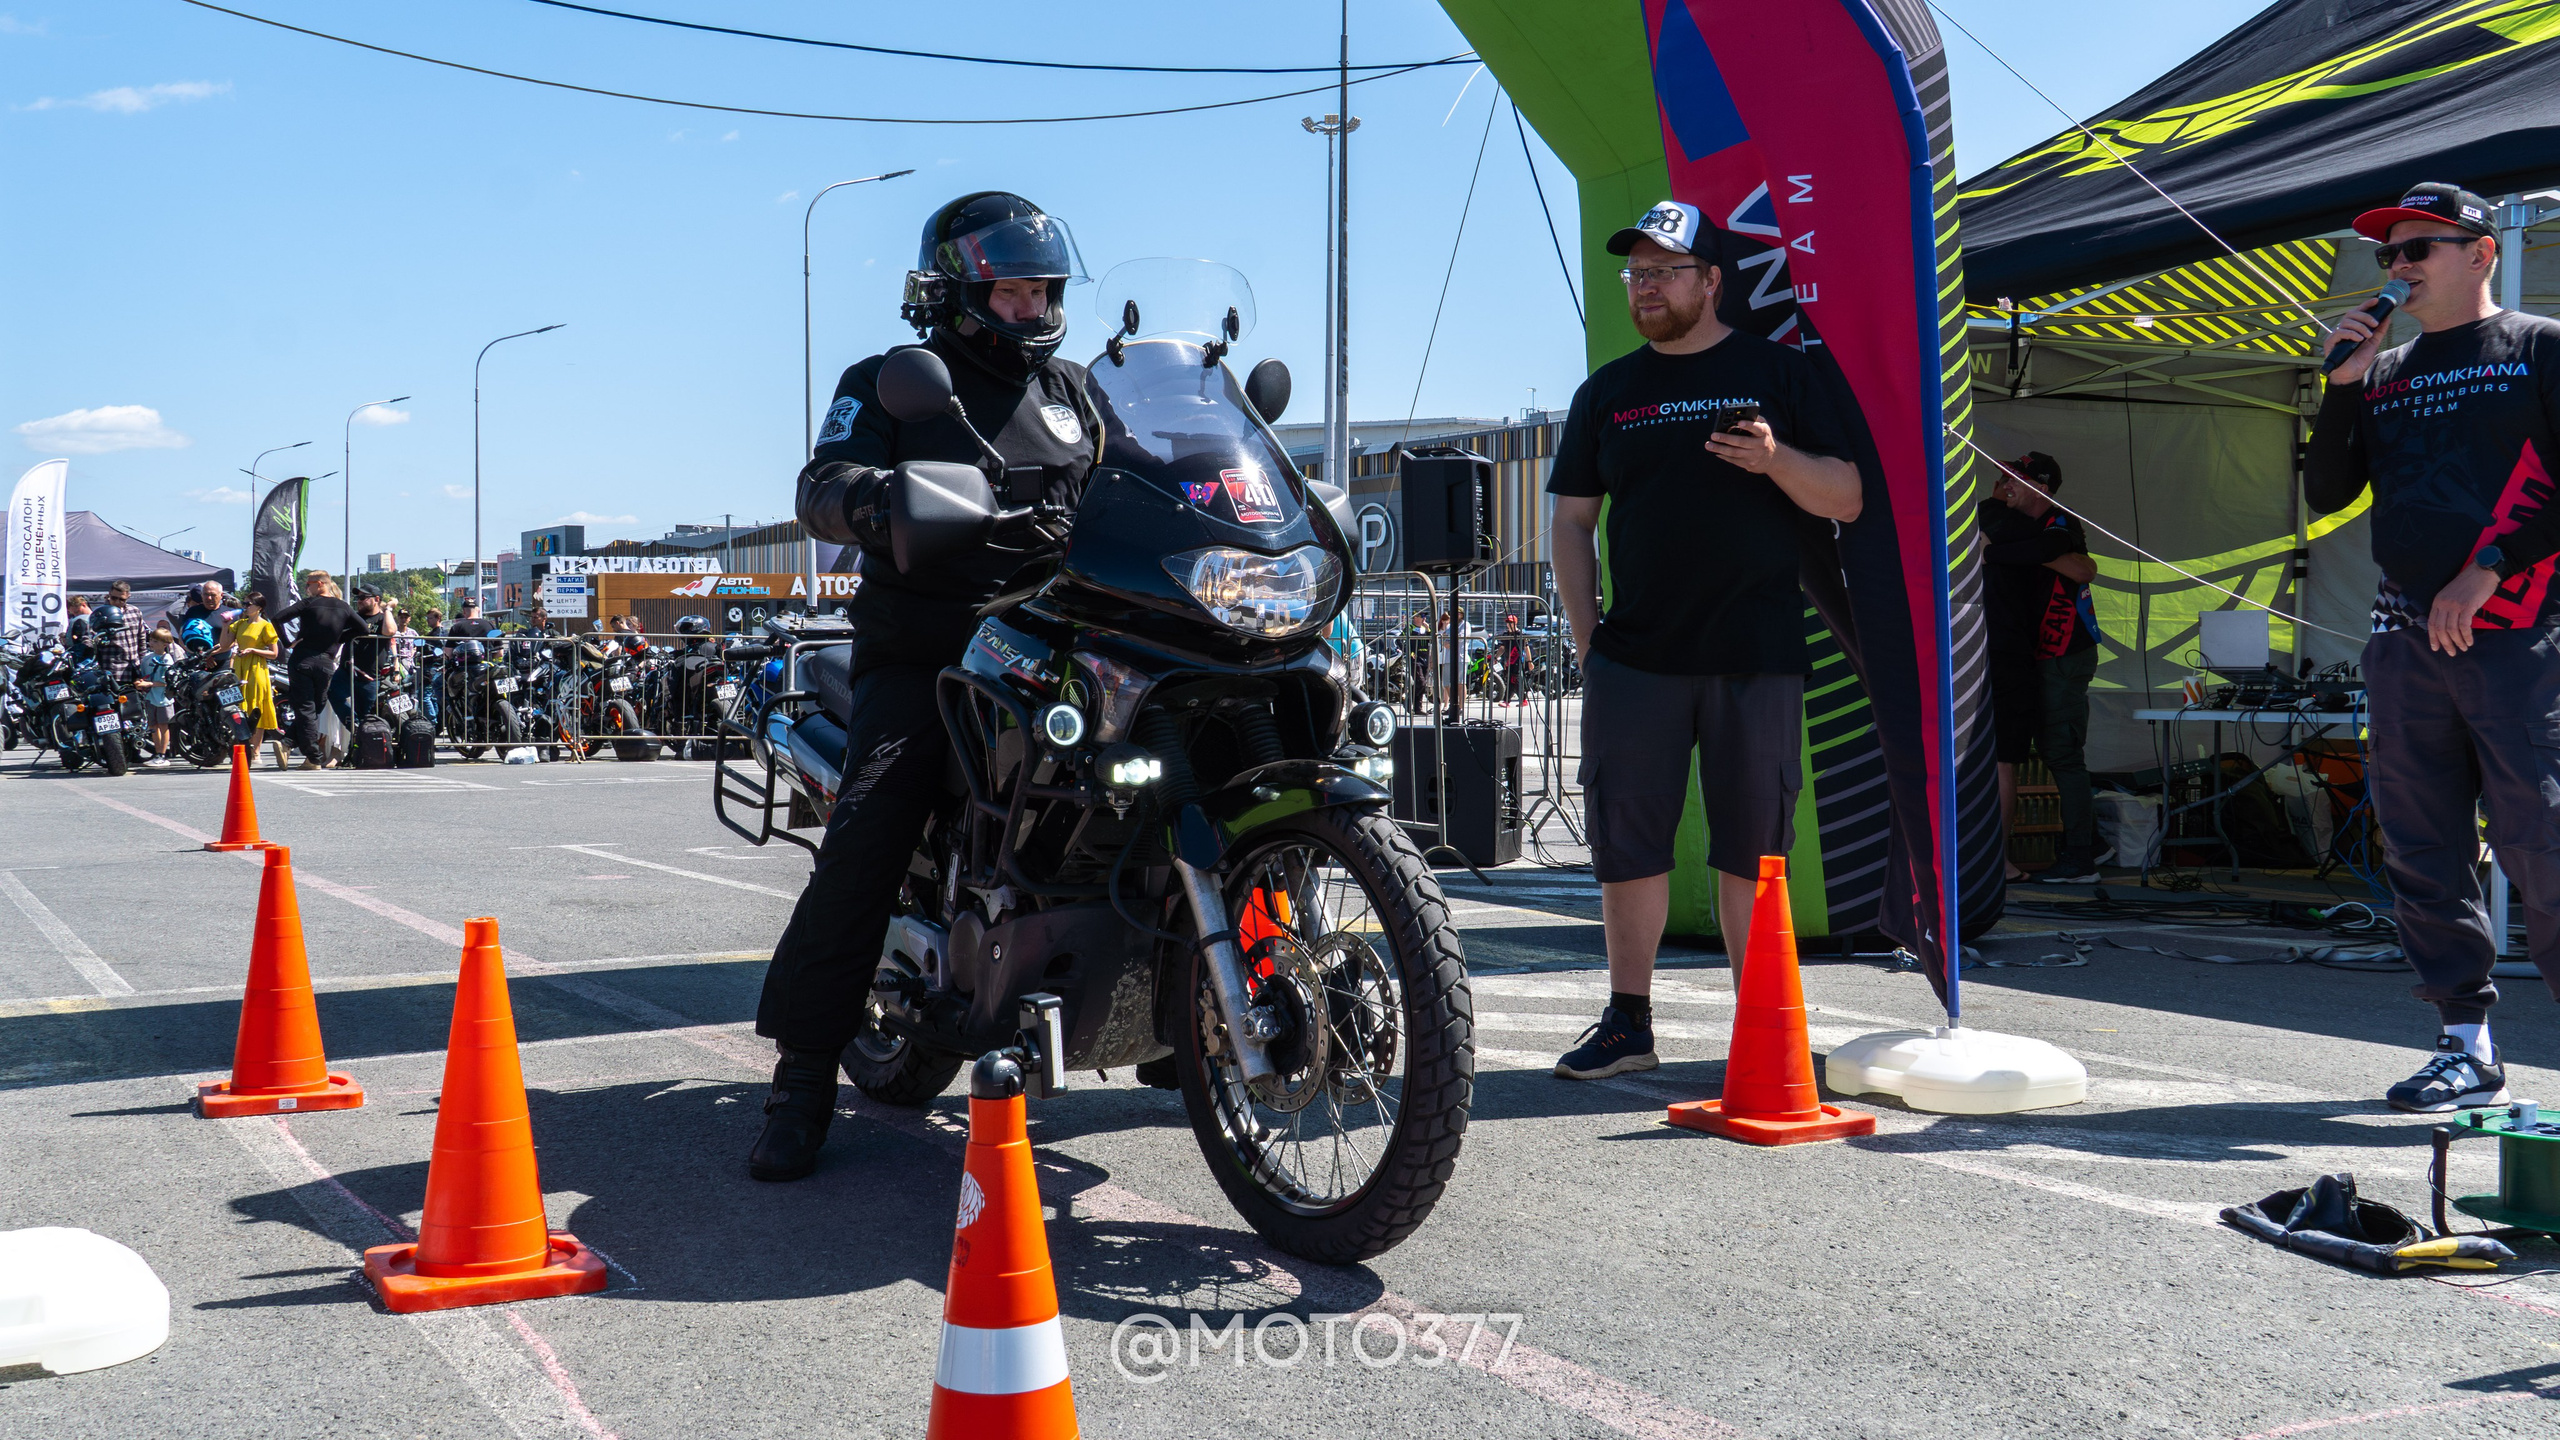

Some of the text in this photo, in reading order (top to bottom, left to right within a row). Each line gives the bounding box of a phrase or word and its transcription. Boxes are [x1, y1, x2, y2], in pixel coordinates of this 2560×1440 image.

[1788, 174, 1822, 354] TEAM
[2364, 362, 2529, 401] MOTOGYMKHANA
[2373, 383, 2509, 415] EKATERINBURG
[1622, 414, 1708, 430] EKATERINBURG
[2412, 402, 2459, 418] TEAM
[1246, 483, 1276, 506] 40
[21, 498, 32, 577] МОТОСАЛОН
[35, 495, 46, 578] УВЛЕЧЁННЫХ
[1362, 514, 1387, 571] P
[49, 534, 61, 579] ЛЮДЕЙ
[716, 586, 771, 595] ЯПОНЕЦ
[718, 577, 753, 585] АВТО
[820, 668, 853, 704] HONDA
